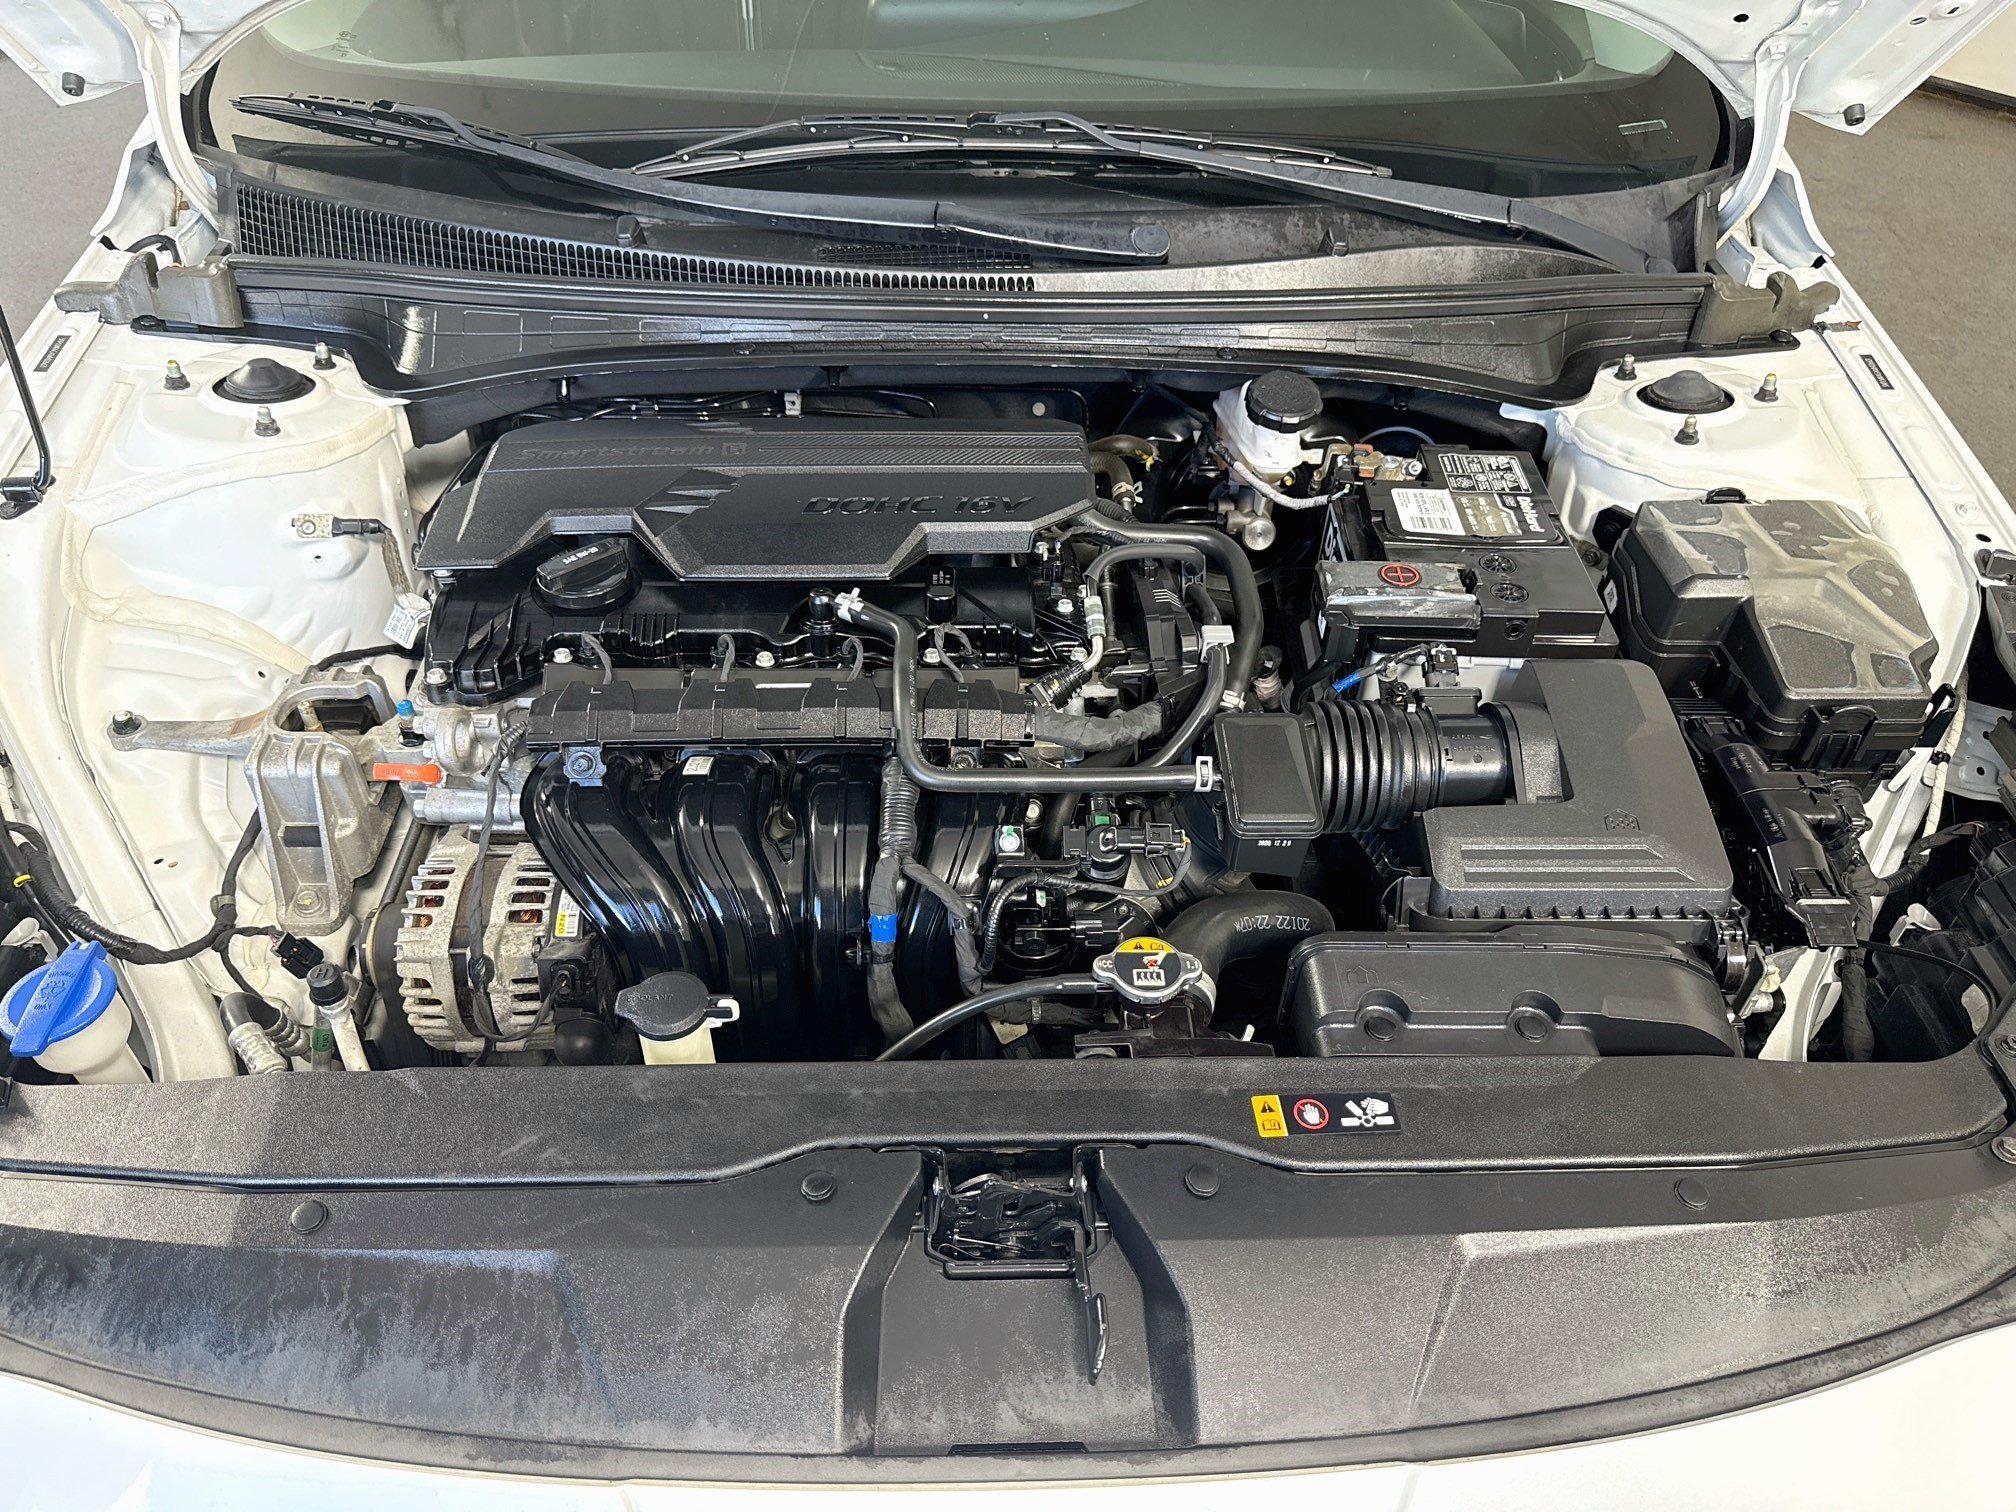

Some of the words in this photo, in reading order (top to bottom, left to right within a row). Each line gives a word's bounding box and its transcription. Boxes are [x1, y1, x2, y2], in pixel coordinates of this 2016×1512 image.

[514, 446, 715, 460] Smartstream
[802, 495, 943, 514] DOHC
[954, 495, 1033, 513] 16V
[1516, 496, 1545, 533] DieHard
[562, 555, 578, 564] SAE
[576, 546, 599, 558] 0W-20
[558, 914, 566, 934] N20
[1096, 960, 1113, 968] HCC
[1186, 960, 1199, 969] 1.1
